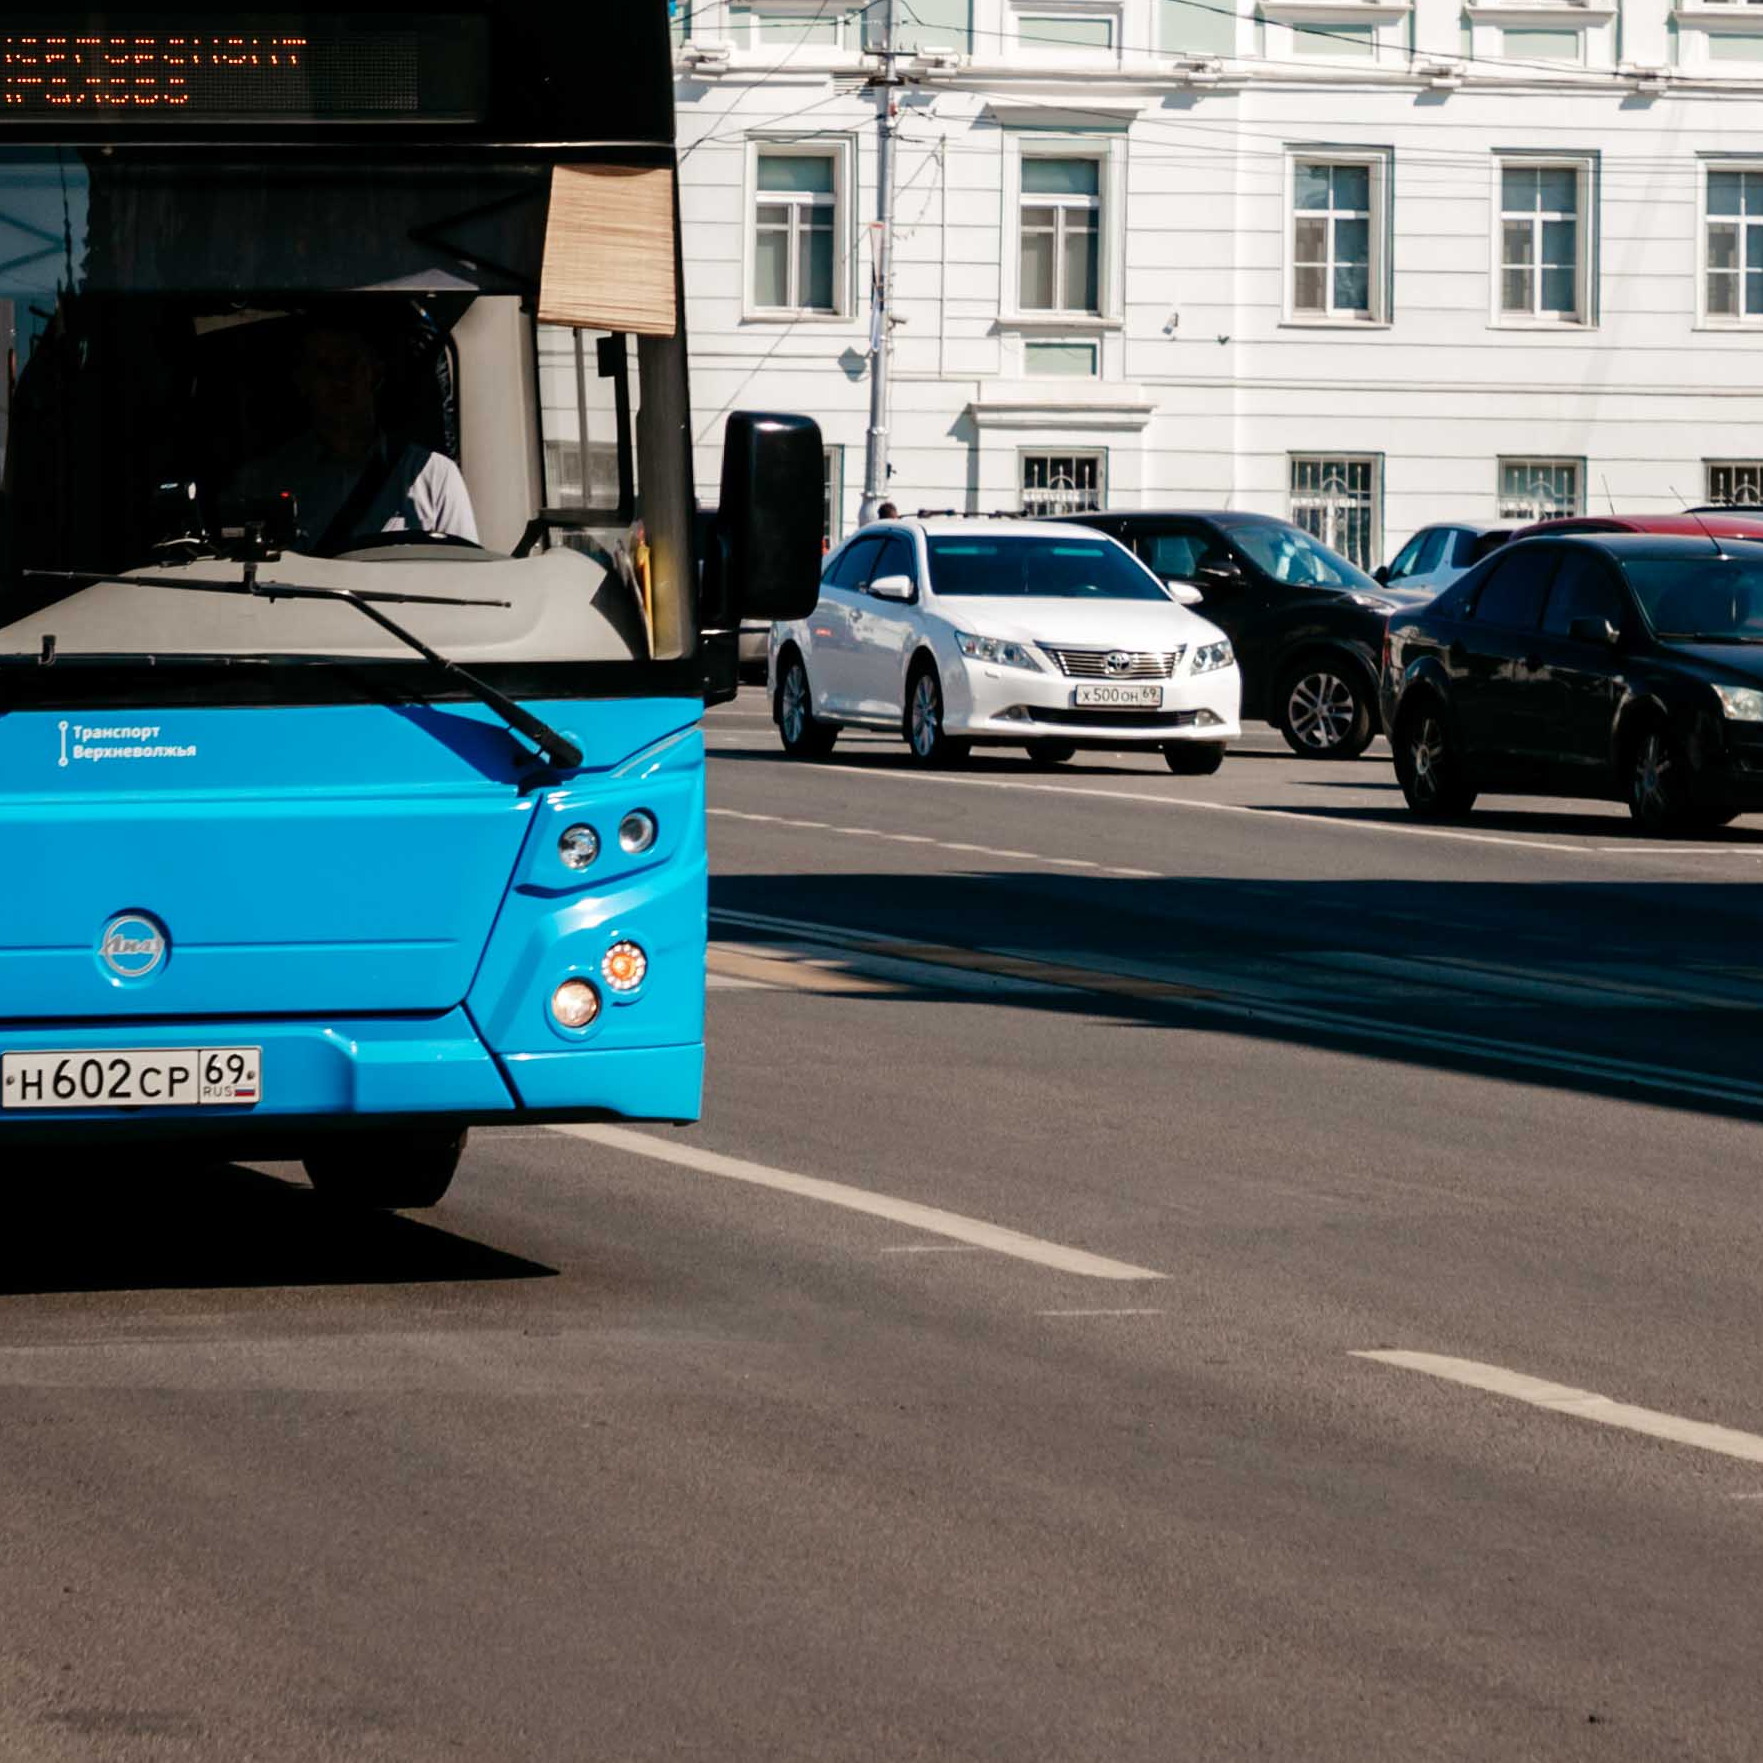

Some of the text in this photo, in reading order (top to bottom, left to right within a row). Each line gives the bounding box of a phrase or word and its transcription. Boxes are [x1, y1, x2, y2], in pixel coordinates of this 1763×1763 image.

[73, 725, 160, 742] Транспорт
[73, 744, 197, 762] Верхневолжья
[204, 1053, 245, 1085] 69
[202, 1086, 233, 1098] RUS
